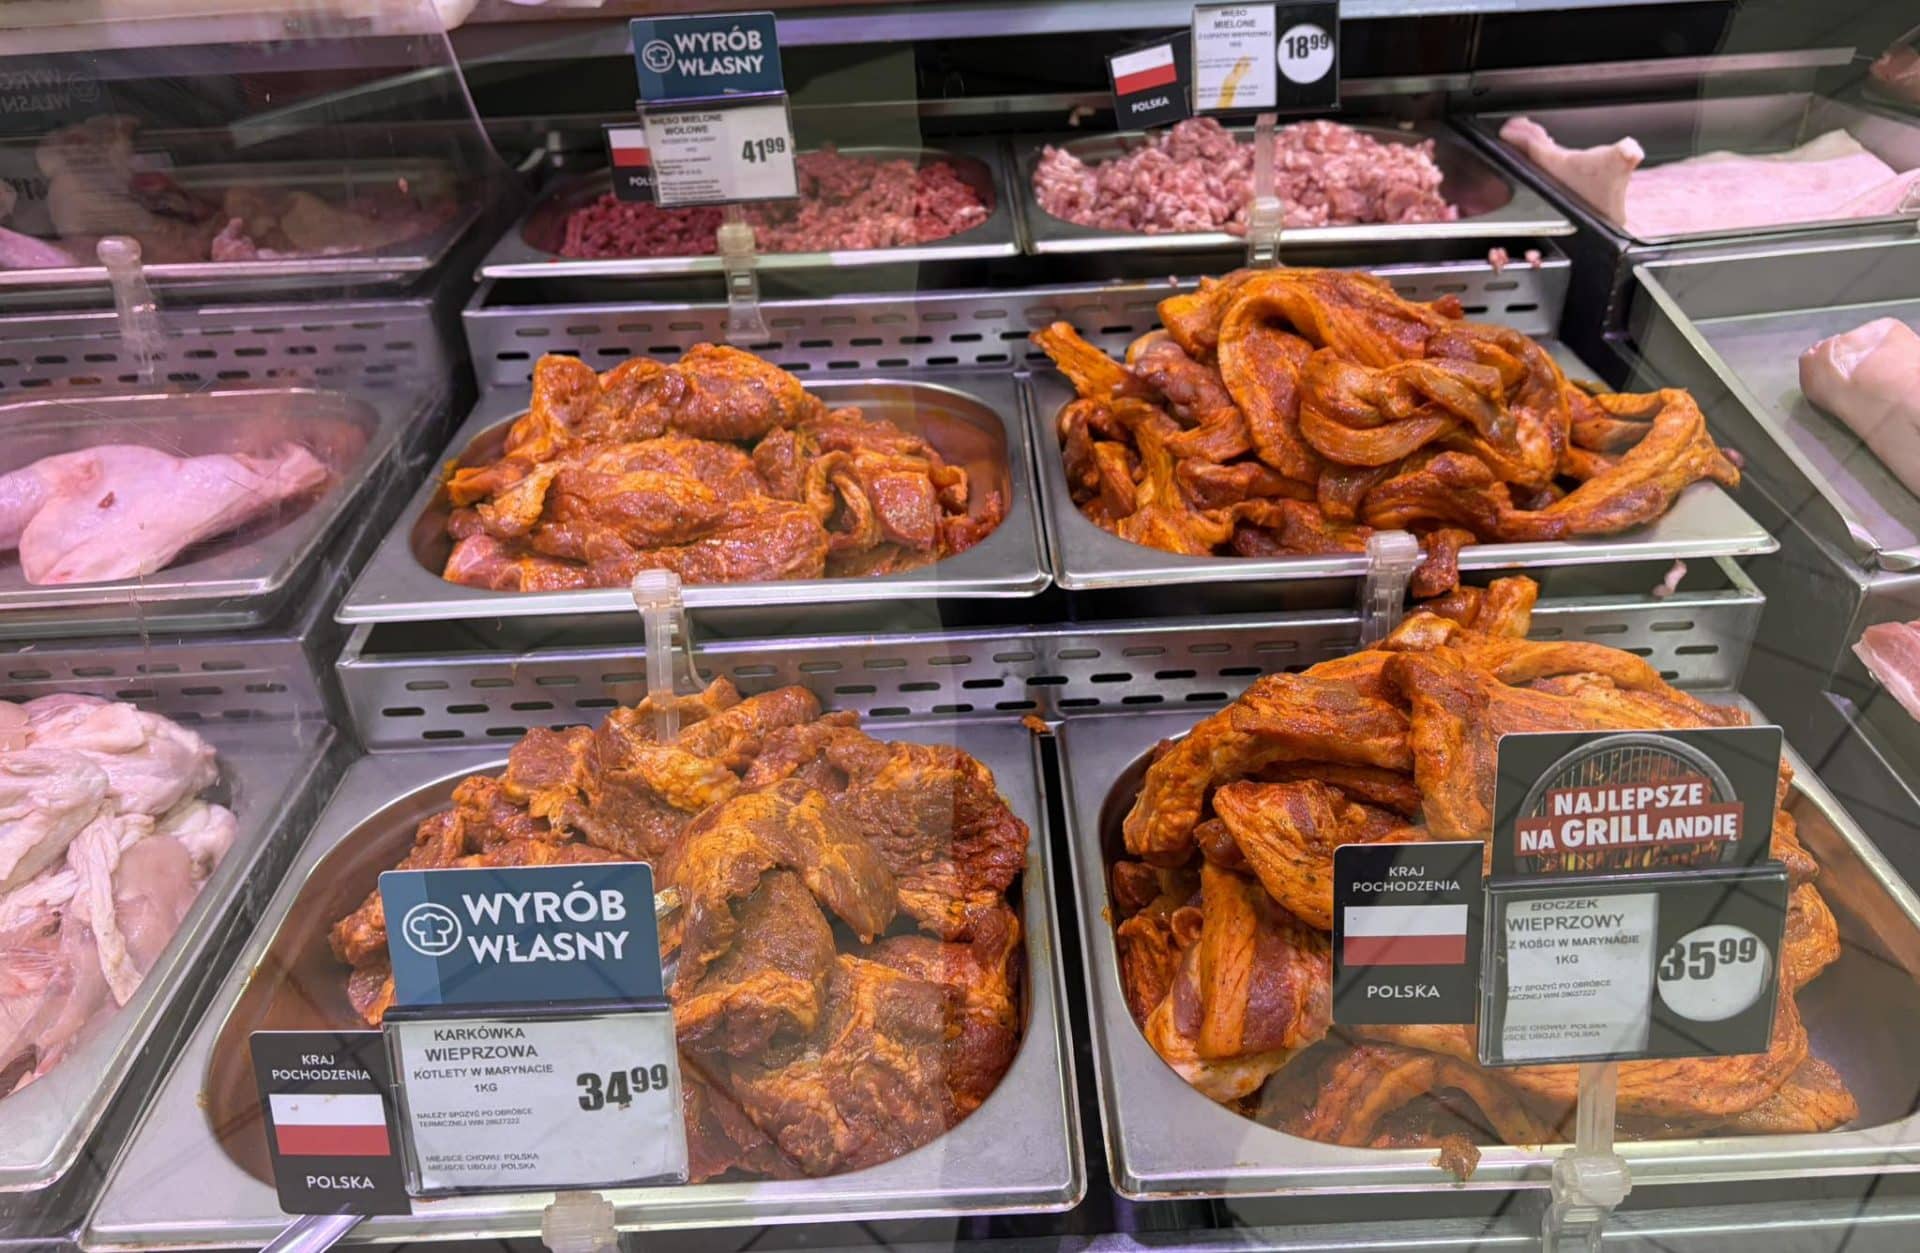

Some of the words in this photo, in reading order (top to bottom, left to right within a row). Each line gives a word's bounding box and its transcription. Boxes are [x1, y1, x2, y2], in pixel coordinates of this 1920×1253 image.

[674, 26, 763, 54] WYRÓB
[1285, 33, 1330, 60] 1899
[677, 55, 764, 76] WŁASNY
[1131, 96, 1170, 113] POLSKA
[742, 137, 786, 163] 4199
[1554, 783, 1704, 816] NAJLEPSZE
[1520, 829, 1555, 851] NA
[1561, 813, 1738, 848] GRILLANDIĘ
[1388, 866, 1425, 877] KRAJ
[1352, 880, 1461, 893] POCHODZENIA
[462, 880, 627, 926] WYRÓB
[1530, 899, 1599, 911] BOCZEK
[1507, 914, 1625, 931] WIEPRZOWY
[467, 931, 630, 965] WŁASNY
[1520, 937, 1555, 949] KOŚCI
[1558, 939, 1569, 948] W
[1571, 935, 1640, 947] MARYNACIE
[1556, 954, 1579, 965] 1KG
[1659, 937, 1758, 981] 3599
[1367, 984, 1441, 998] POLSKA
[433, 1025, 526, 1041] KARKÓWKA
[301, 1054, 335, 1065] KRAJ
[424, 1044, 538, 1062] WIEPRZOWA
[271, 1069, 372, 1080] POCHODZENIA
[413, 1068, 467, 1080] KOTLETY
[470, 1067, 482, 1077] W
[485, 1064, 554, 1076] MARYNACIE
[474, 1083, 498, 1093] 1KG
[576, 1064, 669, 1111] 3499
[503, 1152, 540, 1160] POLSKA
[501, 1162, 536, 1170] POLSKA
[306, 1174, 375, 1190] POLSKA
